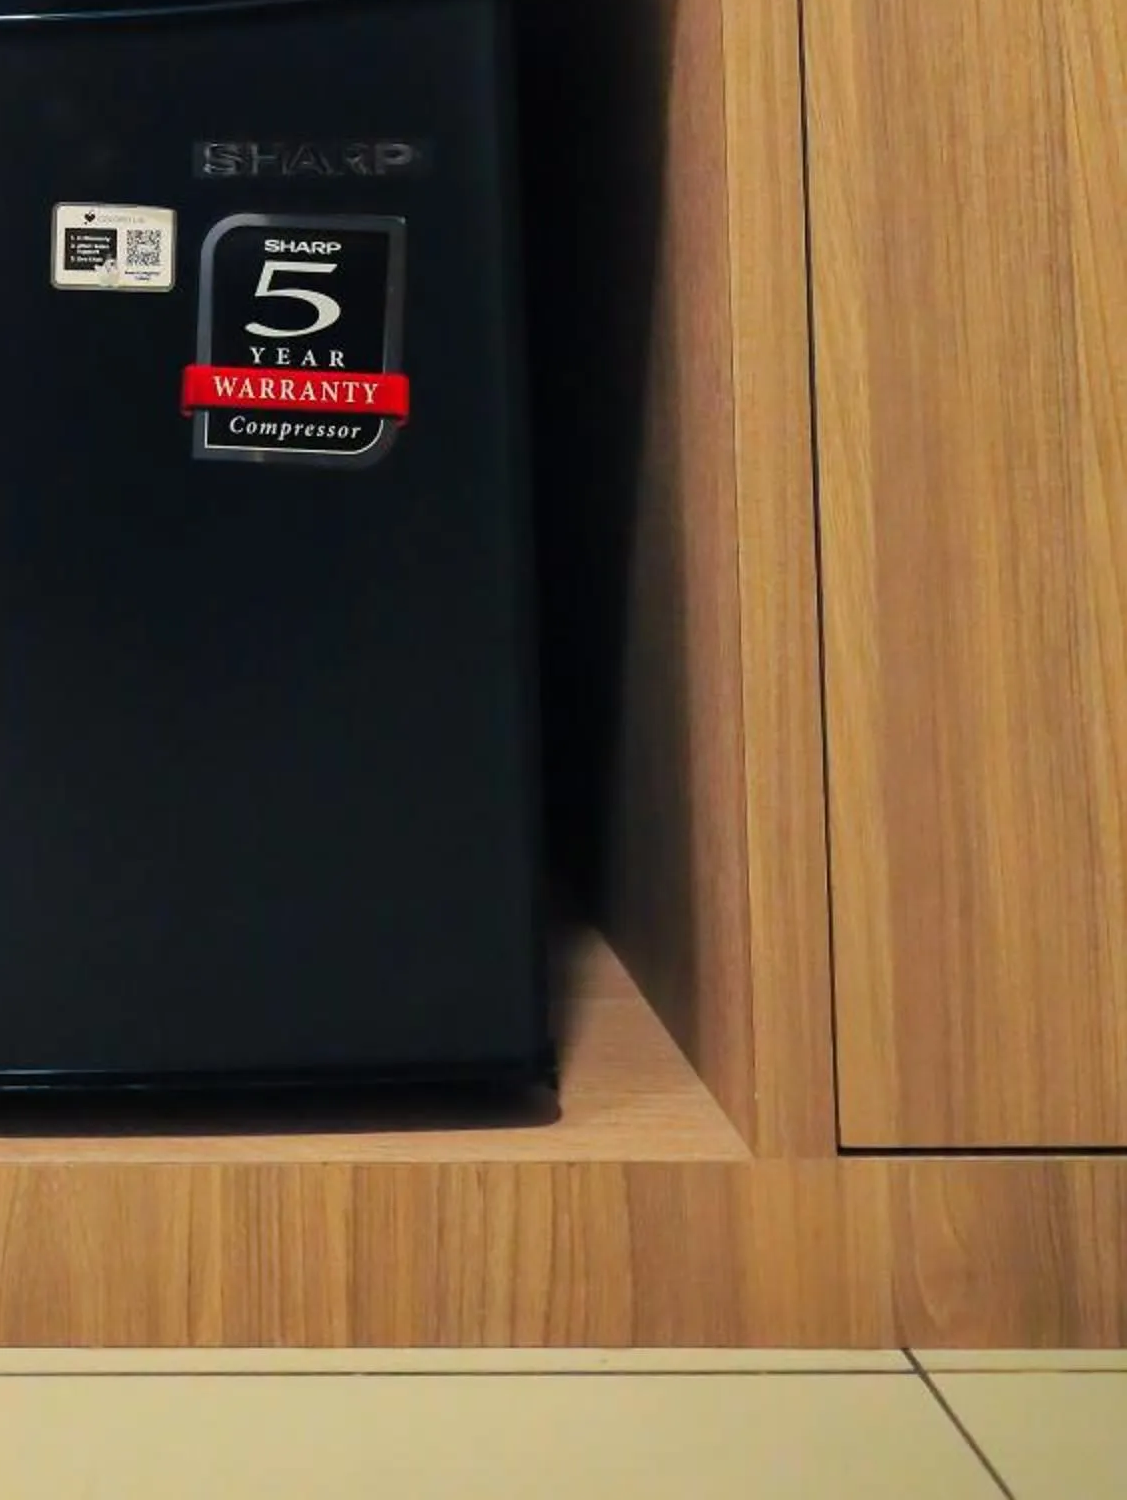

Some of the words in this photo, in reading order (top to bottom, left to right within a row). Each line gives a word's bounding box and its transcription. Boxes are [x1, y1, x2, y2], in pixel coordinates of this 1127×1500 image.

[203, 142, 414, 176] SHARP
[264, 239, 341, 254] SHARP
[245, 260, 341, 338] 5
[249, 347, 346, 368] YEAR
[213, 375, 379, 404] WARRANTY
[229, 415, 362, 441] Compressor
